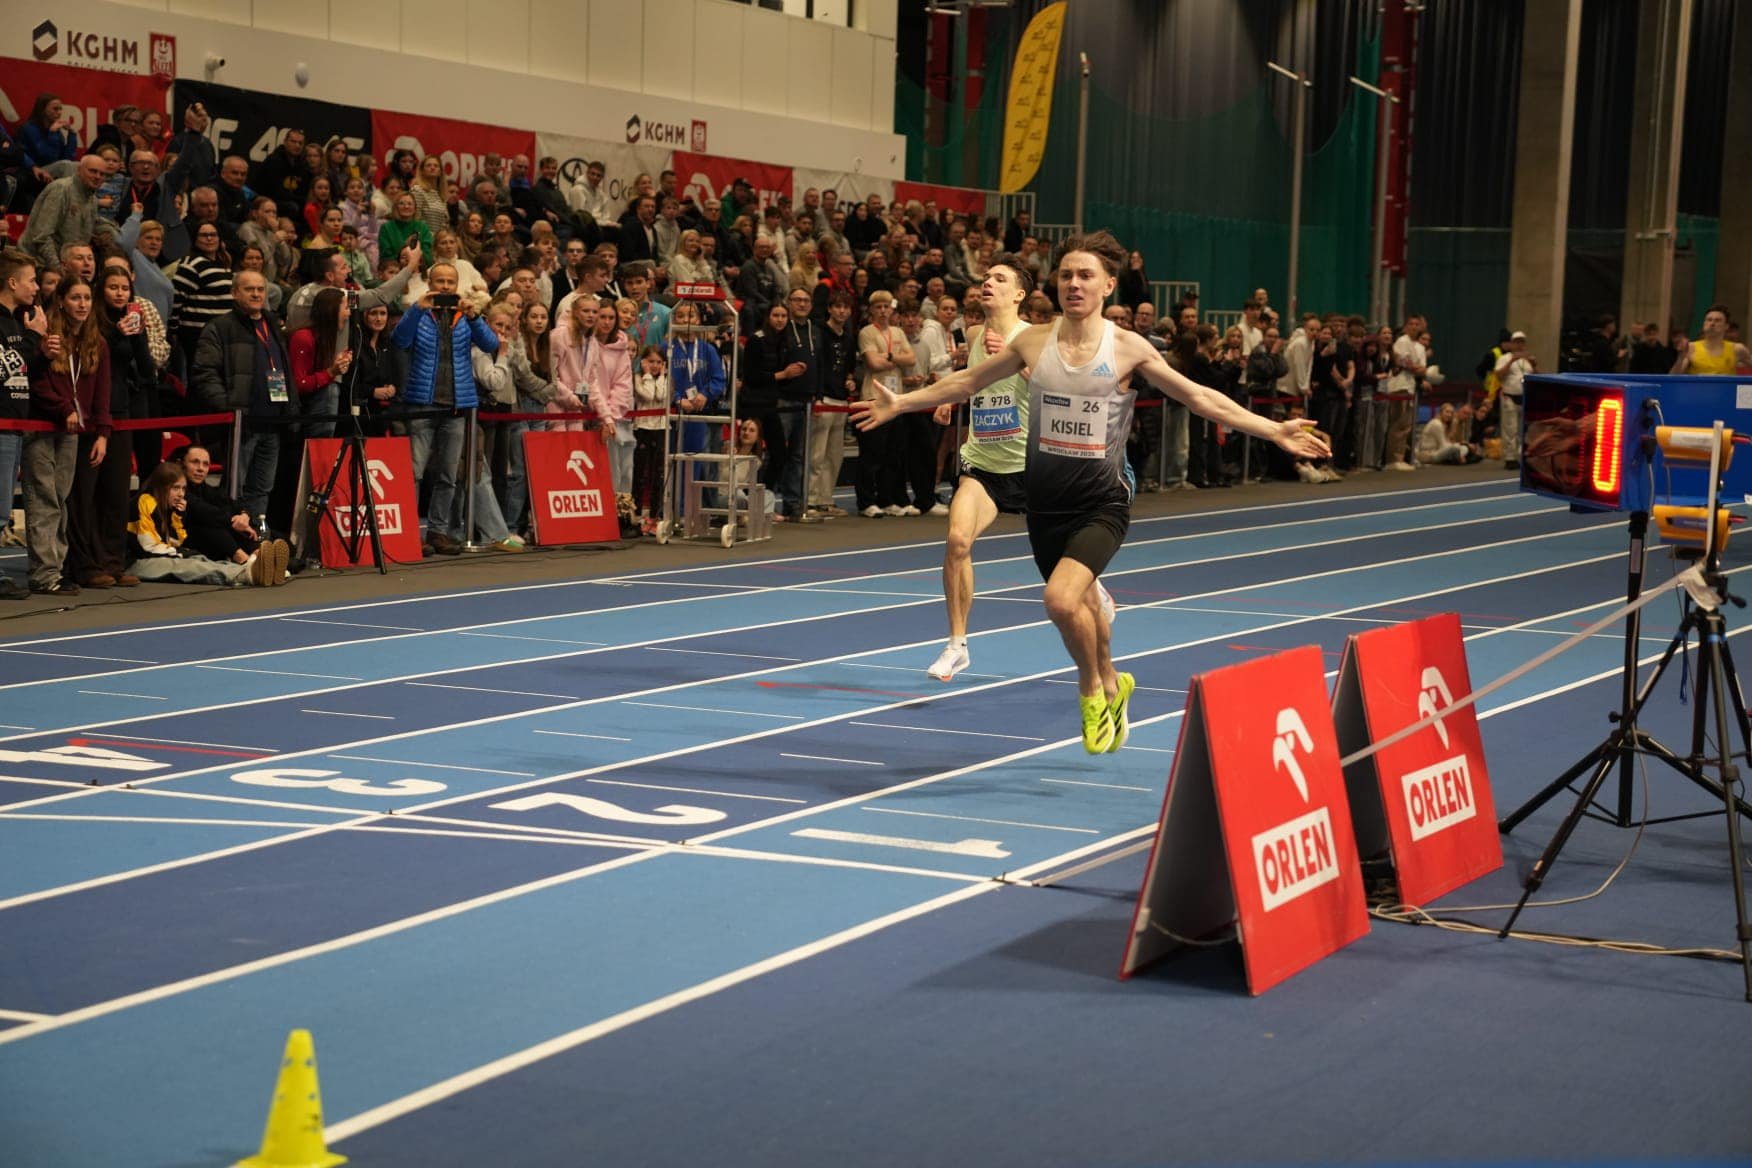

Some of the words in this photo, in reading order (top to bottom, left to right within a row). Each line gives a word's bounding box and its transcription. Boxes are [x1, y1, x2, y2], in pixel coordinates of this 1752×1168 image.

[67, 30, 138, 66] KGHM
[644, 121, 686, 145] KGHM
[991, 395, 1012, 407] 978
[1082, 400, 1100, 413] 26
[974, 411, 1015, 427] ZACZYK
[1051, 418, 1094, 437] KISIEL
[1592, 398, 1623, 492] 0
[552, 493, 599, 514] ORLEN
[229, 767, 448, 796] 3
[487, 791, 728, 826] 2
[1409, 765, 1471, 828] ORLEN
[789, 827, 1013, 859] 1
[1261, 820, 1332, 896] ORLEN
